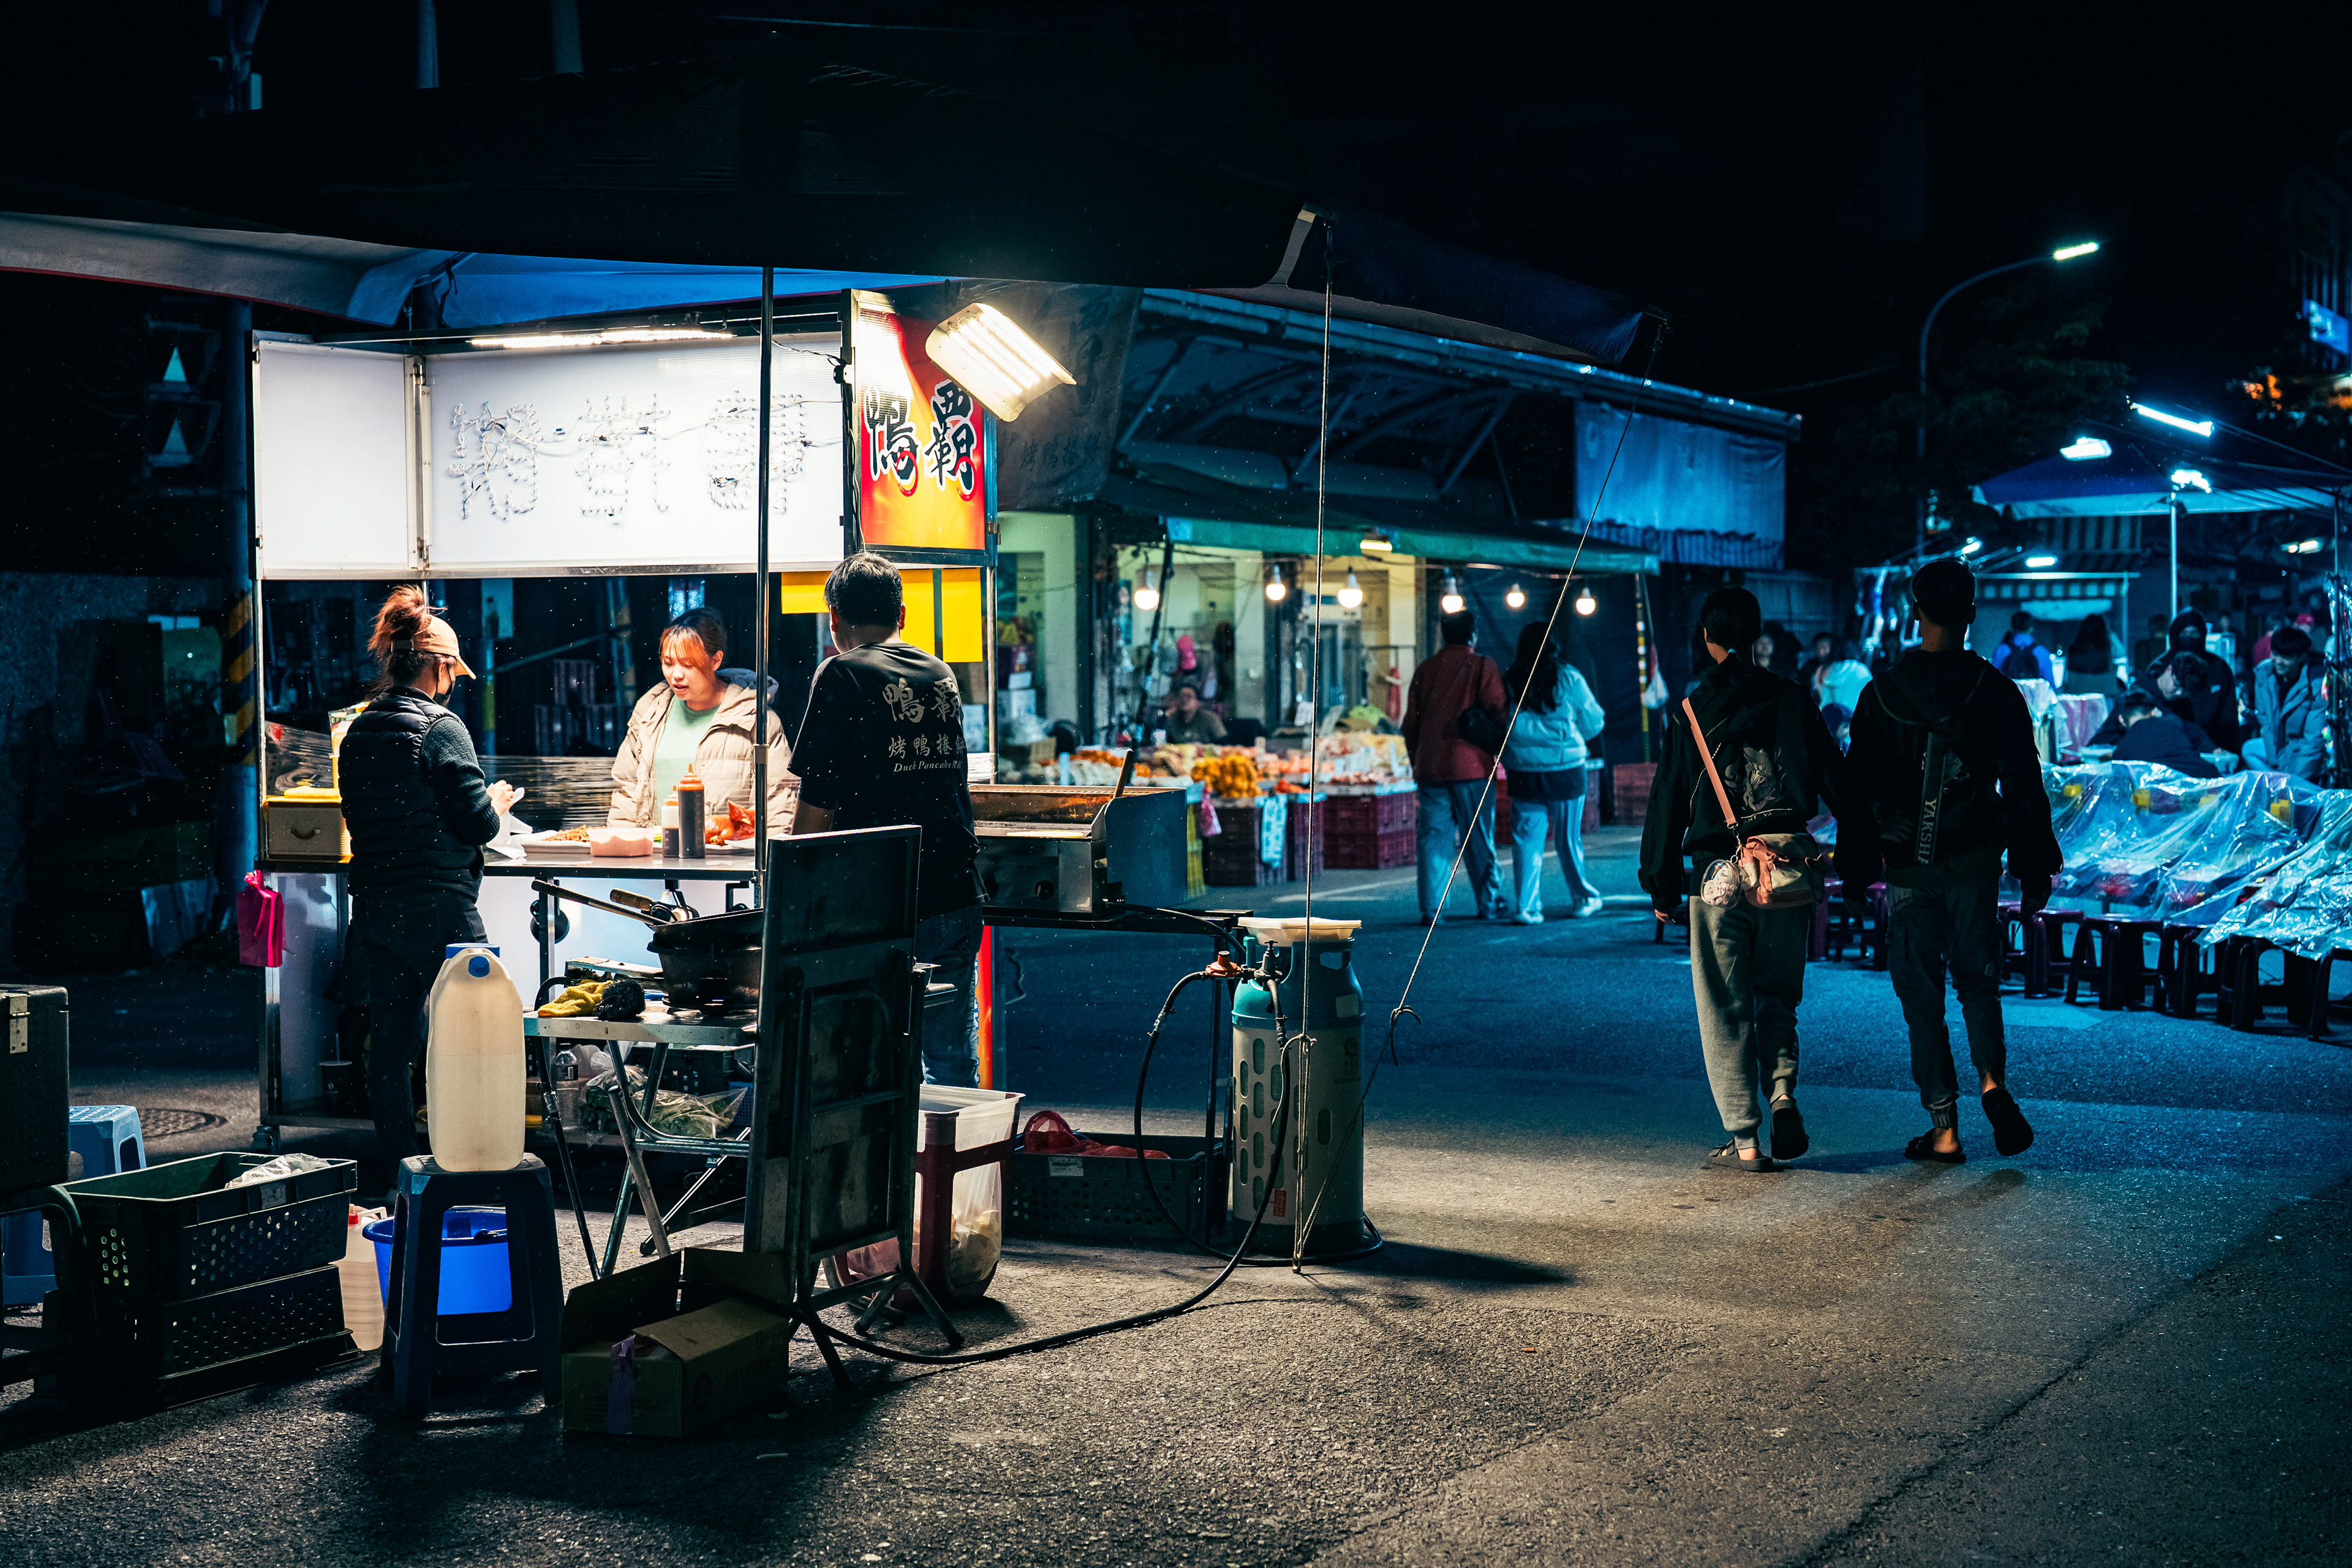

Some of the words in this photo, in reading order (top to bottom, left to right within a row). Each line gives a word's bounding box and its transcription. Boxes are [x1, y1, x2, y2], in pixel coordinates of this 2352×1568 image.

[888, 733, 966, 759] 烤鴨捲餅
[893, 761, 916, 772] Duck
[918, 760, 951, 770] Pancake
